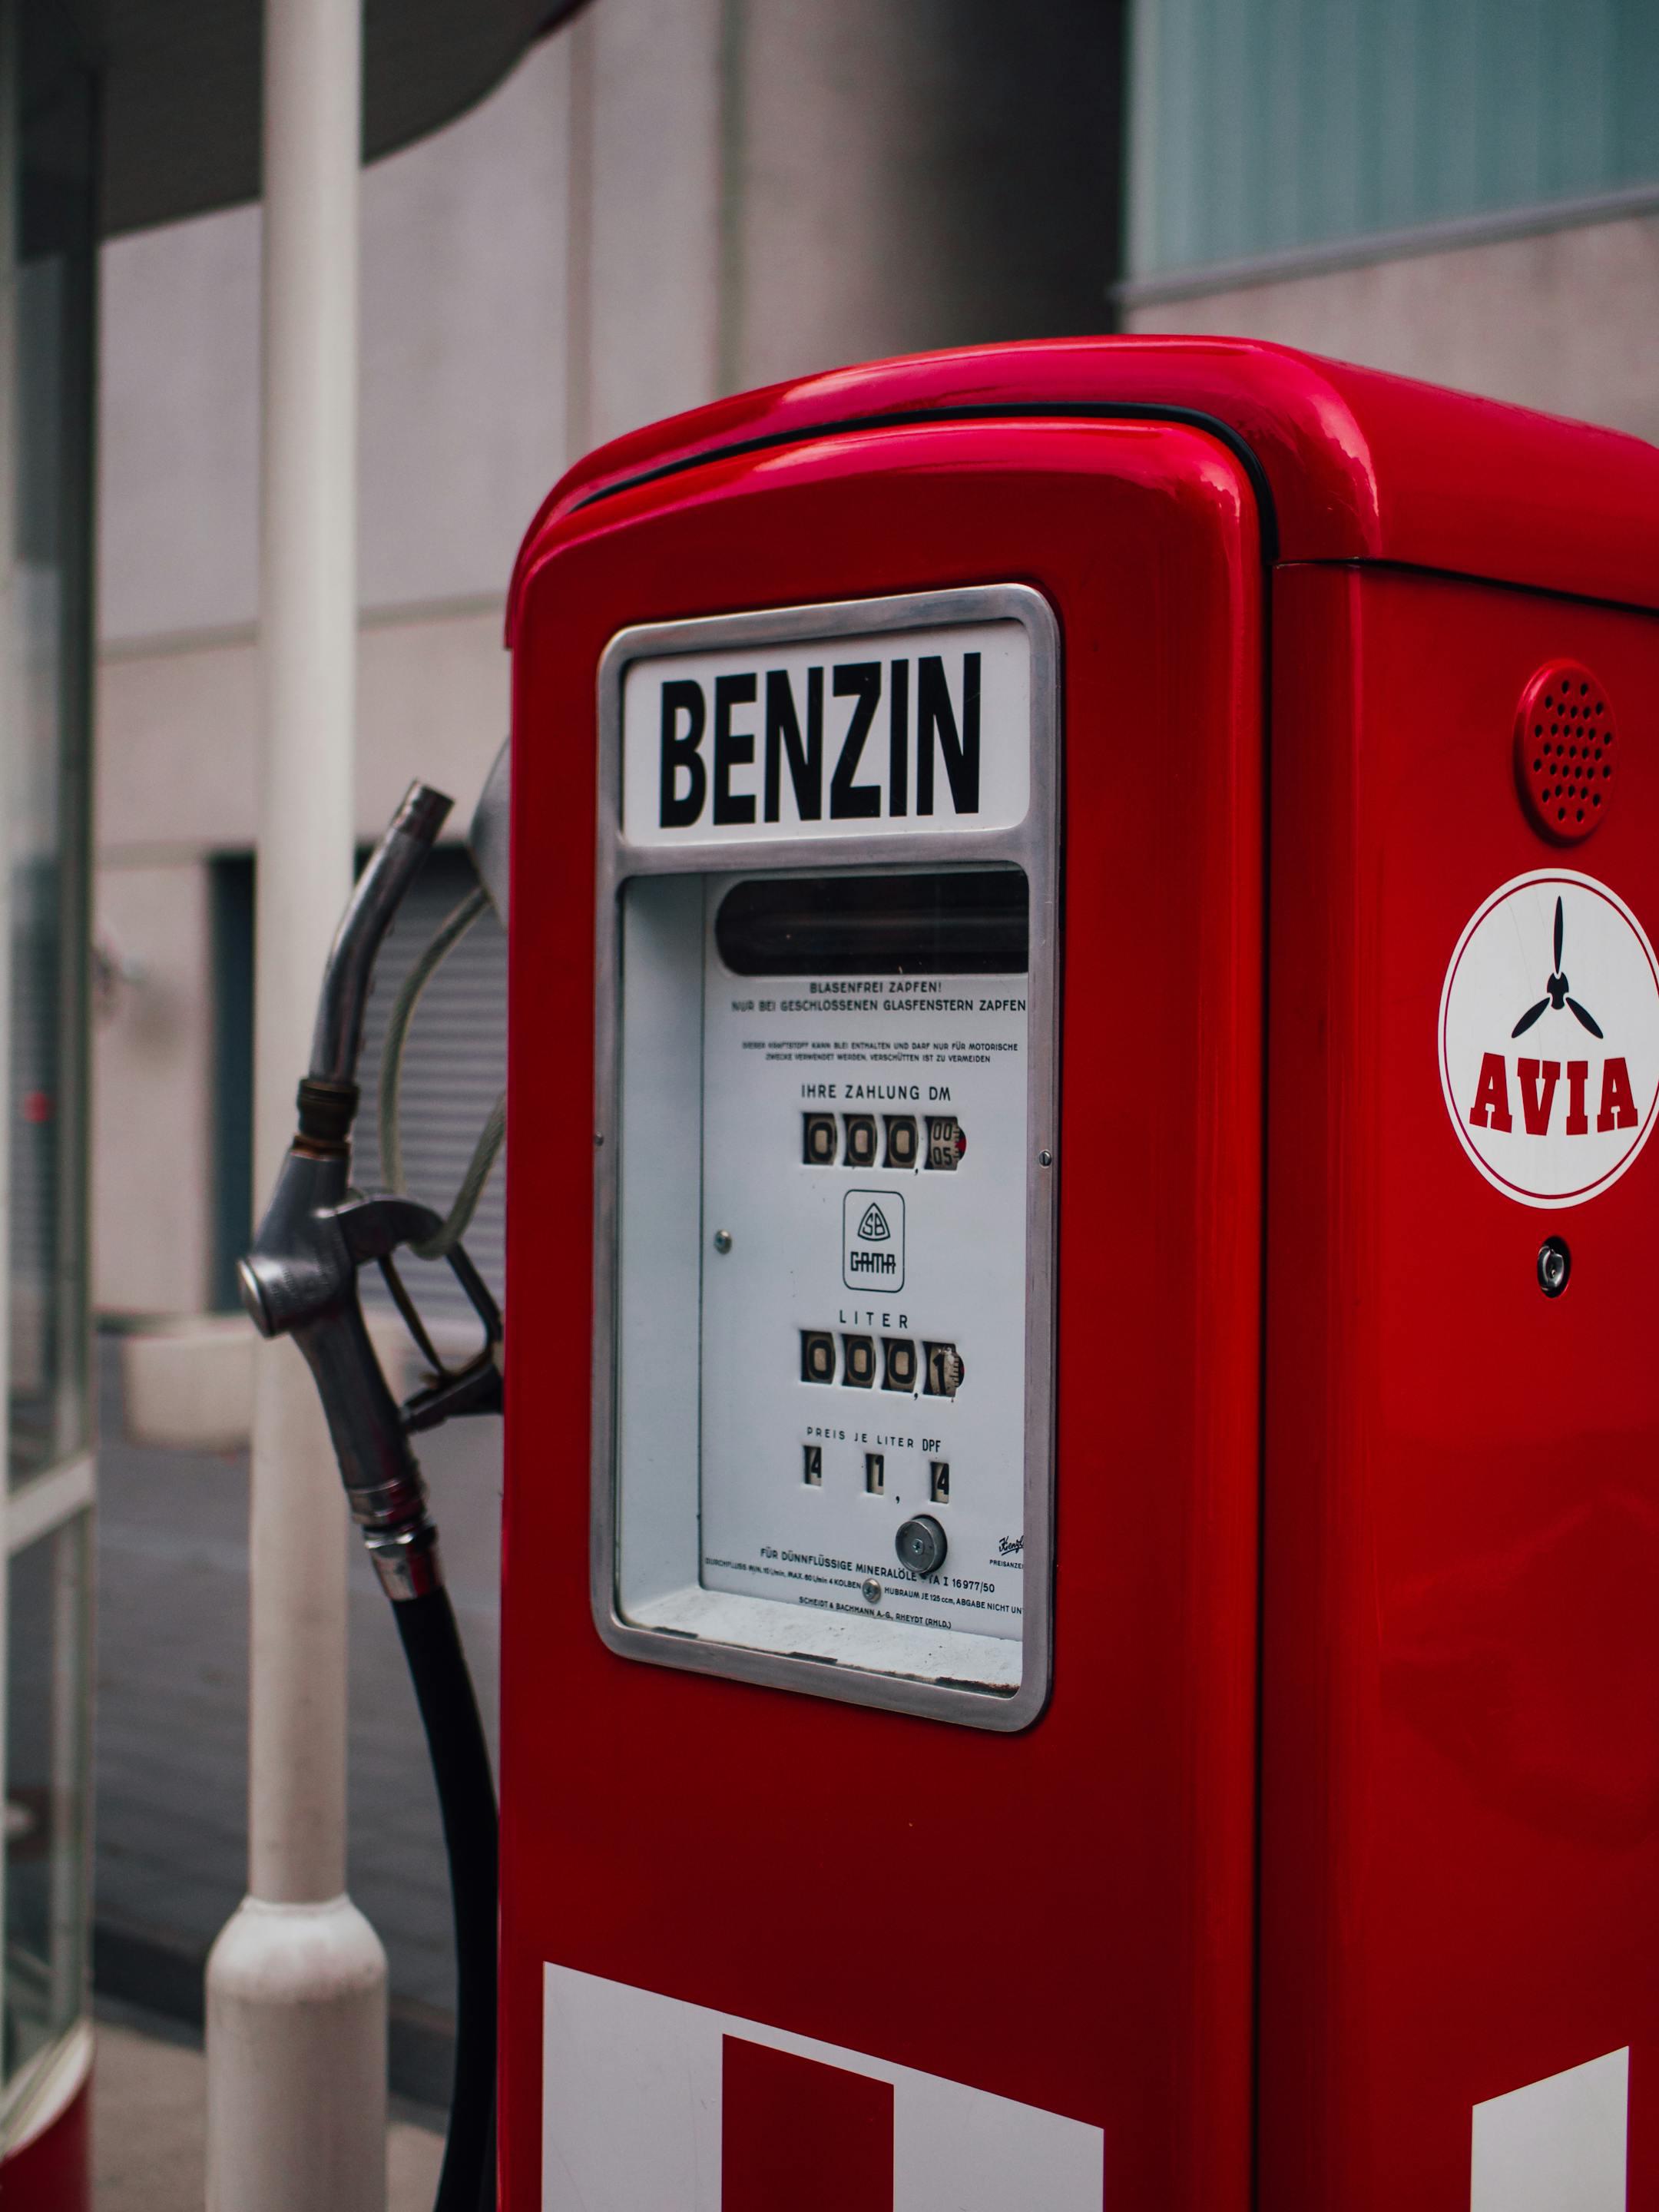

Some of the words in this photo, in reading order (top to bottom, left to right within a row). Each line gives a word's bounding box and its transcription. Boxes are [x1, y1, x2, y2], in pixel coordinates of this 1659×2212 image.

[659, 652, 982, 830] BENZIN
[810, 982, 883, 994] BLASENFREI
[889, 982, 942, 993] ZAPFEN!
[731, 1002, 754, 1012] NUR
[758, 1001, 776, 1012] BEI
[780, 1000, 878, 1012] GESCHLOSSENEN
[883, 1000, 973, 1011] GLASFENSTERN
[979, 1000, 1026, 1011] ZAPFEN
[870, 1052, 919, 1062] VERSCHÜTTEN
[912, 1042, 930, 1051] DARF
[952, 1041, 966, 1051] FÜR
[801, 1084, 836, 1098] IHRE
[845, 1085, 920, 1101] ZAHLUNG
[929, 1087, 951, 1101] DM
[1469, 1052, 1638, 1136] AVIA
[850, 1251, 896, 1275] GAMA
[839, 1310, 909, 1329] LITER
[807, 1426, 846, 1440] PREIS
[854, 1432, 868, 1442] JE
[877, 1435, 914, 1448] LITER
[922, 1439, 941, 1453] DPF
[760, 1546, 778, 1560] FÜR
[781, 1550, 853, 1572] DÜNNFLÜSSIGE
[856, 1563, 917, 1582] MINERALÖLE
[834, 1579, 861, 1589] KOLBEN
[884, 1587, 920, 1599] HUBRAUM
[921, 1592, 929, 1601] JE
[956, 1598, 985, 1609] ABGABE
[987, 1603, 1010, 1613] NICHT
[799, 1596, 828, 1608] SCHEIDT
[836, 1603, 875, 1617] BACHMANN
[896, 1613, 923, 1624] RHEYDT
[925, 1618, 952, 1629] (RHLD.)
